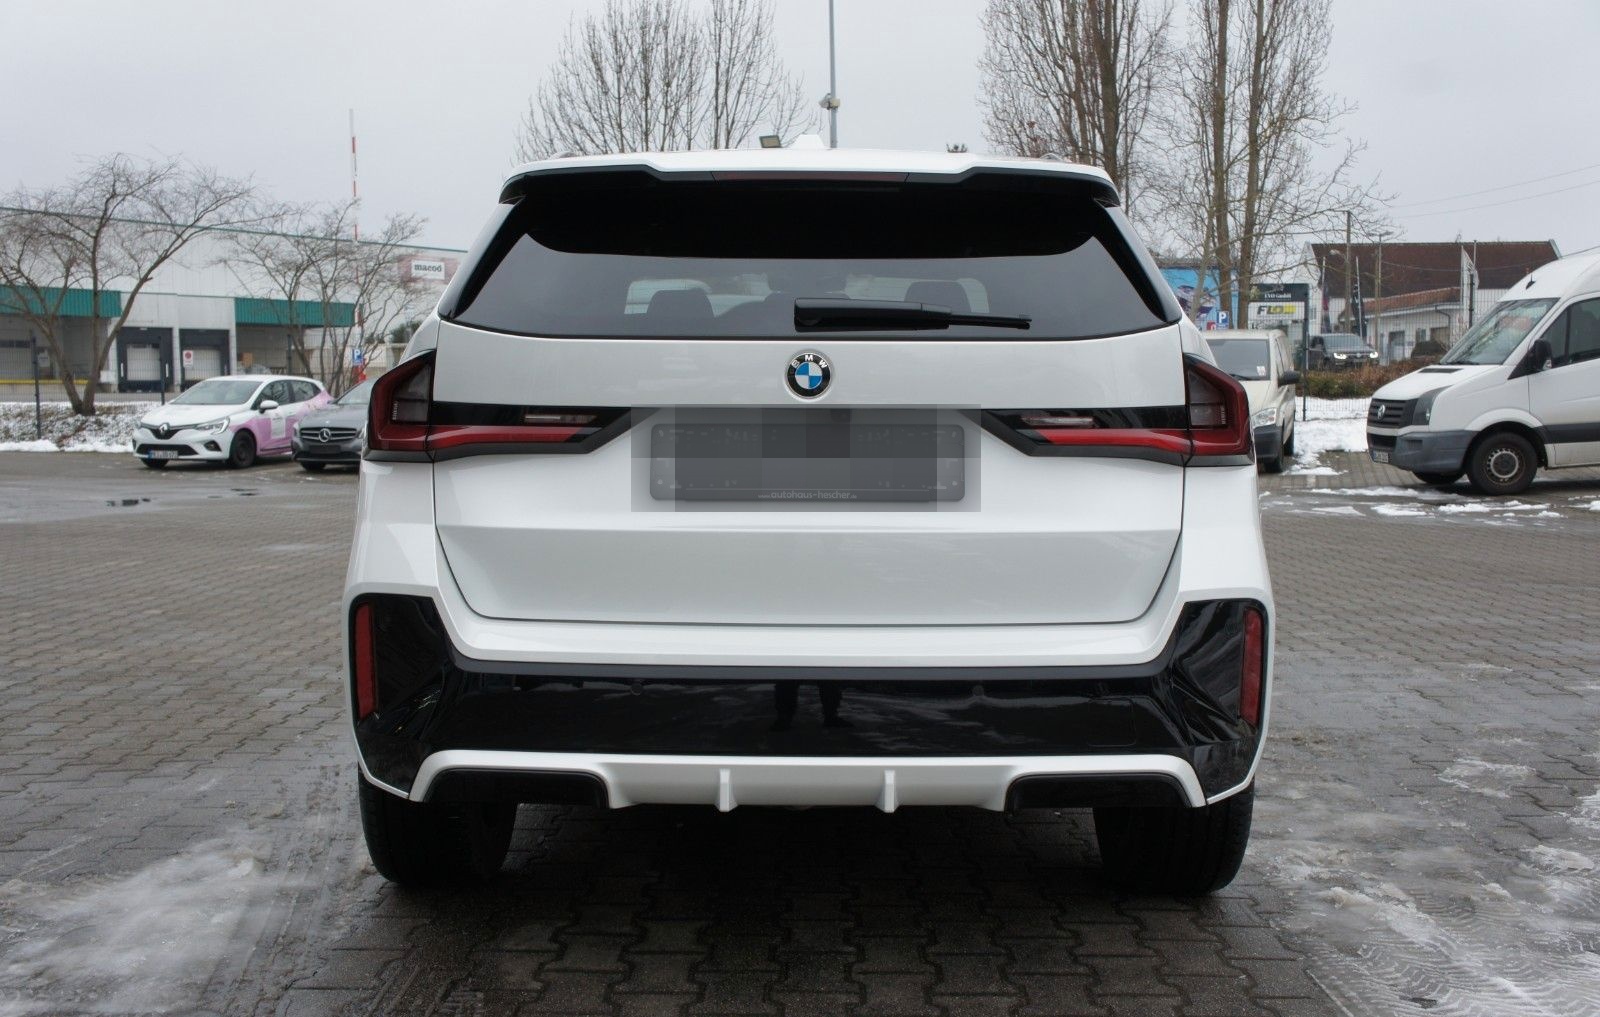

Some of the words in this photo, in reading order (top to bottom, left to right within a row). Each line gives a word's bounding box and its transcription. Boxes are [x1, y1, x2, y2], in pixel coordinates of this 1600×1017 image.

[1219, 312, 1227, 323] P
[354, 350, 361, 360] P
[791, 354, 828, 368] BMW
